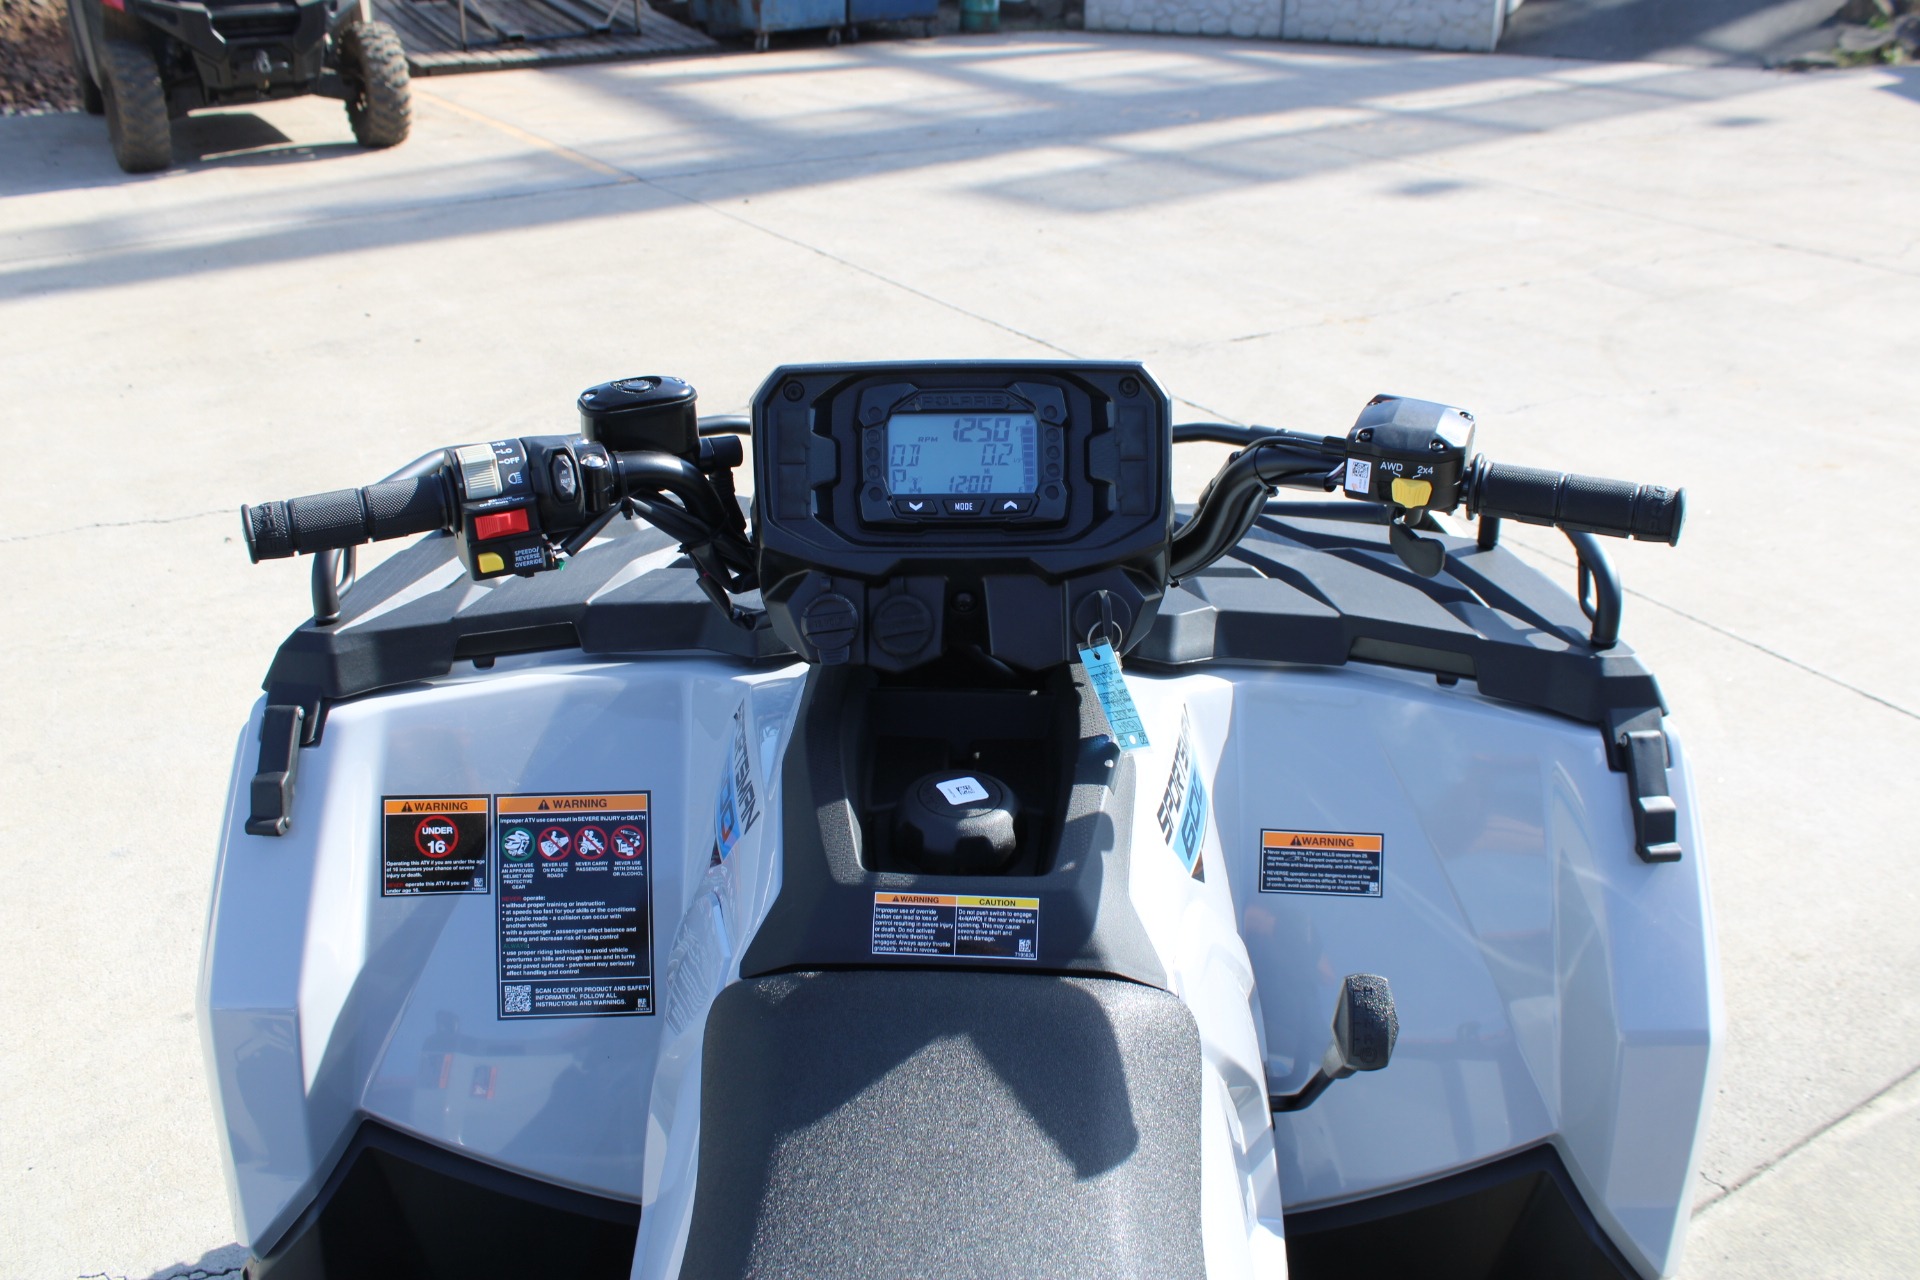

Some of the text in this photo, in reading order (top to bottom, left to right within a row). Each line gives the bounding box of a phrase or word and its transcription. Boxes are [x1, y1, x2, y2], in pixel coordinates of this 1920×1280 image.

[921, 396, 1004, 406] POLARIS
[953, 418, 1011, 442] 1250
[981, 443, 1013, 466] 0.2
[1380, 462, 1403, 471] AWD
[1417, 466, 1434, 474] 2x4
[949, 476, 993, 493] 12:00
[515, 546, 539, 556] SPEEDO/
[516, 553, 540, 562] REVERSE
[515, 558, 542, 568] OVERRIDE
[1156, 702, 1190, 846] SPORTS
[415, 802, 468, 811] WARNING
[553, 799, 607, 808] WARNING
[428, 841, 446, 853] 16
[1302, 837, 1354, 847] WARNING
